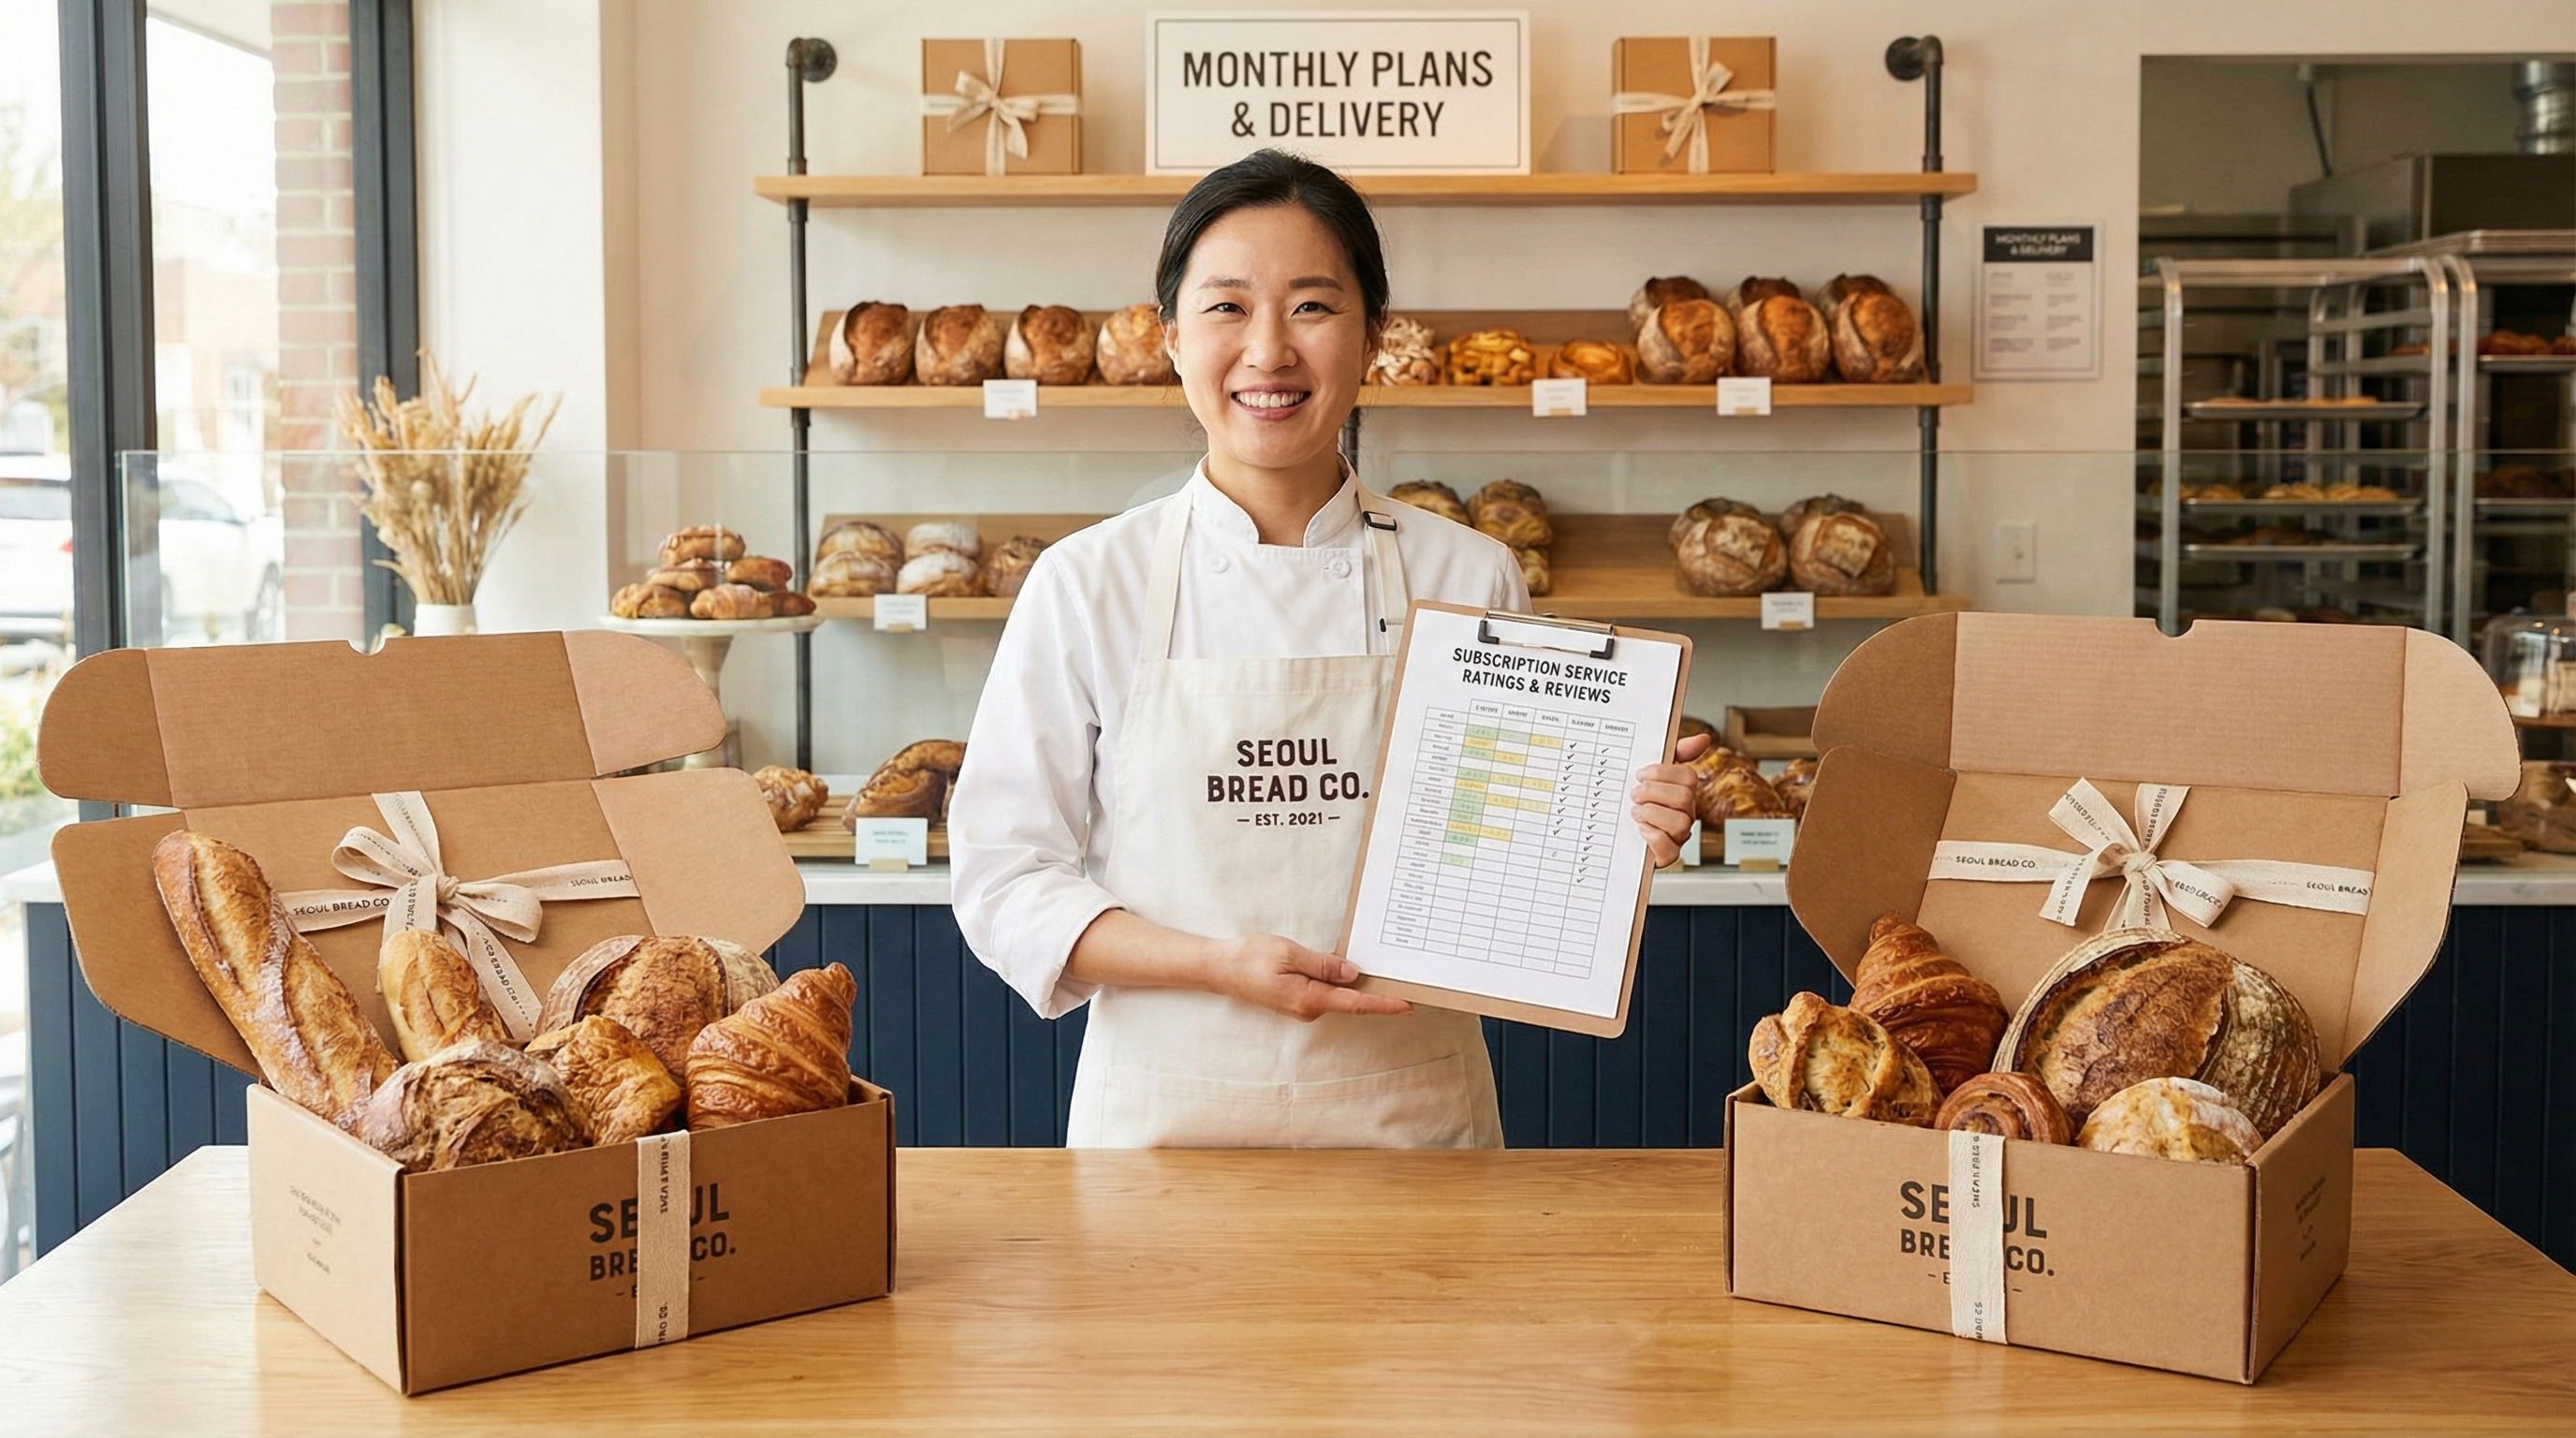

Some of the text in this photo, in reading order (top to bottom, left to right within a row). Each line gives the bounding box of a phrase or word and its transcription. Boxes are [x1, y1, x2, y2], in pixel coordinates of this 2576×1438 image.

[1183, 51, 1494, 87] MONTHLY PLANS
[1231, 101, 1445, 137] & DELIVERY
[1452, 647, 1628, 686] SUBSCRIPTION SERVICE
[1462, 668, 1611, 703] RATINGS & REVIEWS
[1237, 738, 1338, 767] SEOUL
[1207, 771, 1369, 802] BREAD CO.
[1255, 812, 1323, 827] EST. 2021
[1955, 856, 1985, 866] SEOUL
[332, 900, 371, 912] BREAD
[589, 1182, 730, 1243] SEUL
[1899, 1181, 2047, 1240] SEUL
[590, 1231, 737, 1283] BRE CO.
[1900, 1228, 2056, 1277] BRE CO.
